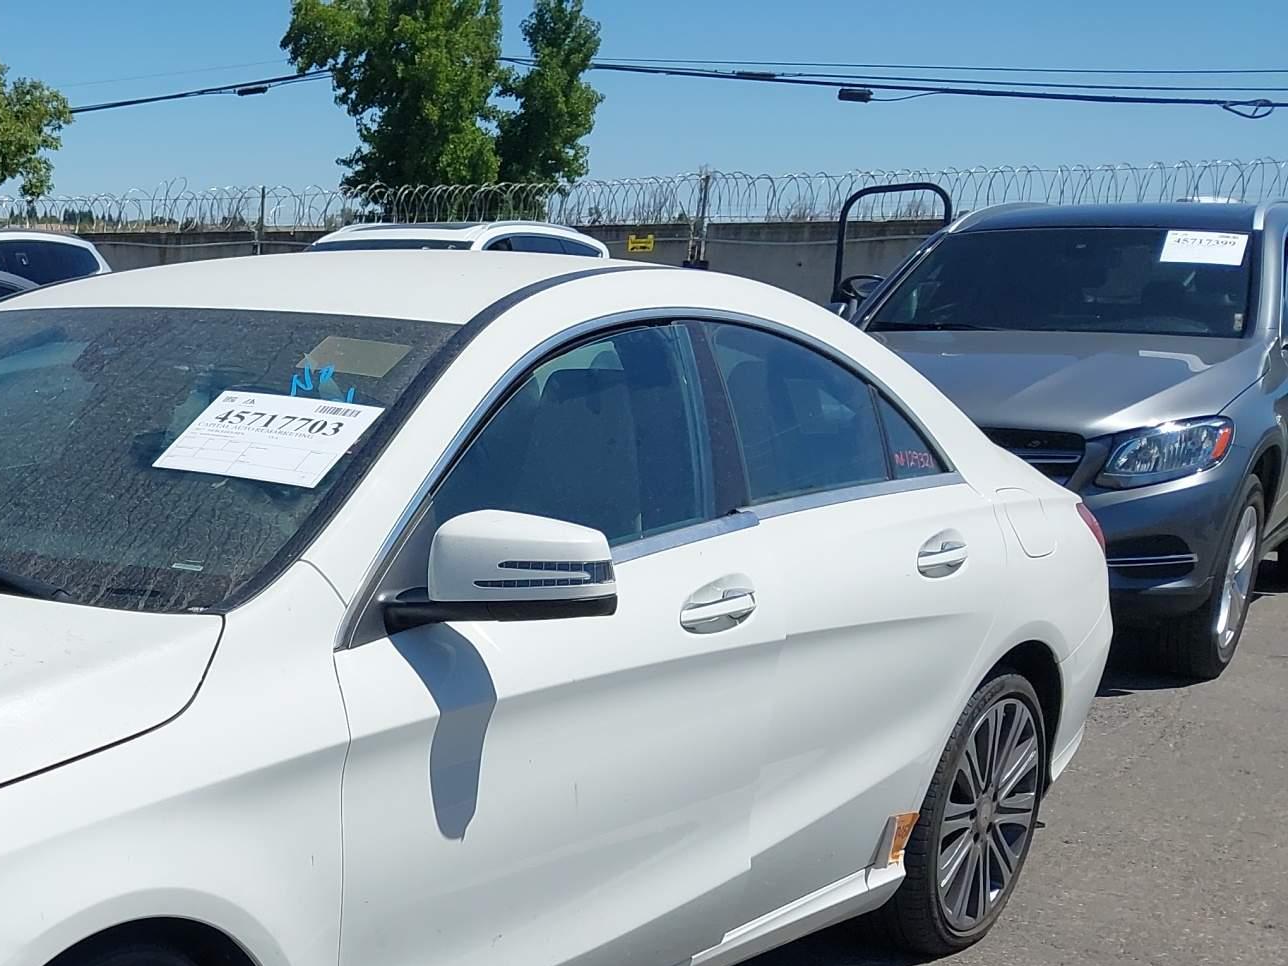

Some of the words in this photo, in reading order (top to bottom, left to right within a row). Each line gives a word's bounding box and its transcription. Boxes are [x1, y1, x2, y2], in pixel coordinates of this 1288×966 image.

[1173, 237, 1237, 247] 45717399
[197, 421, 228, 430] CAPITAL
[214, 409, 345, 437] 45717703
